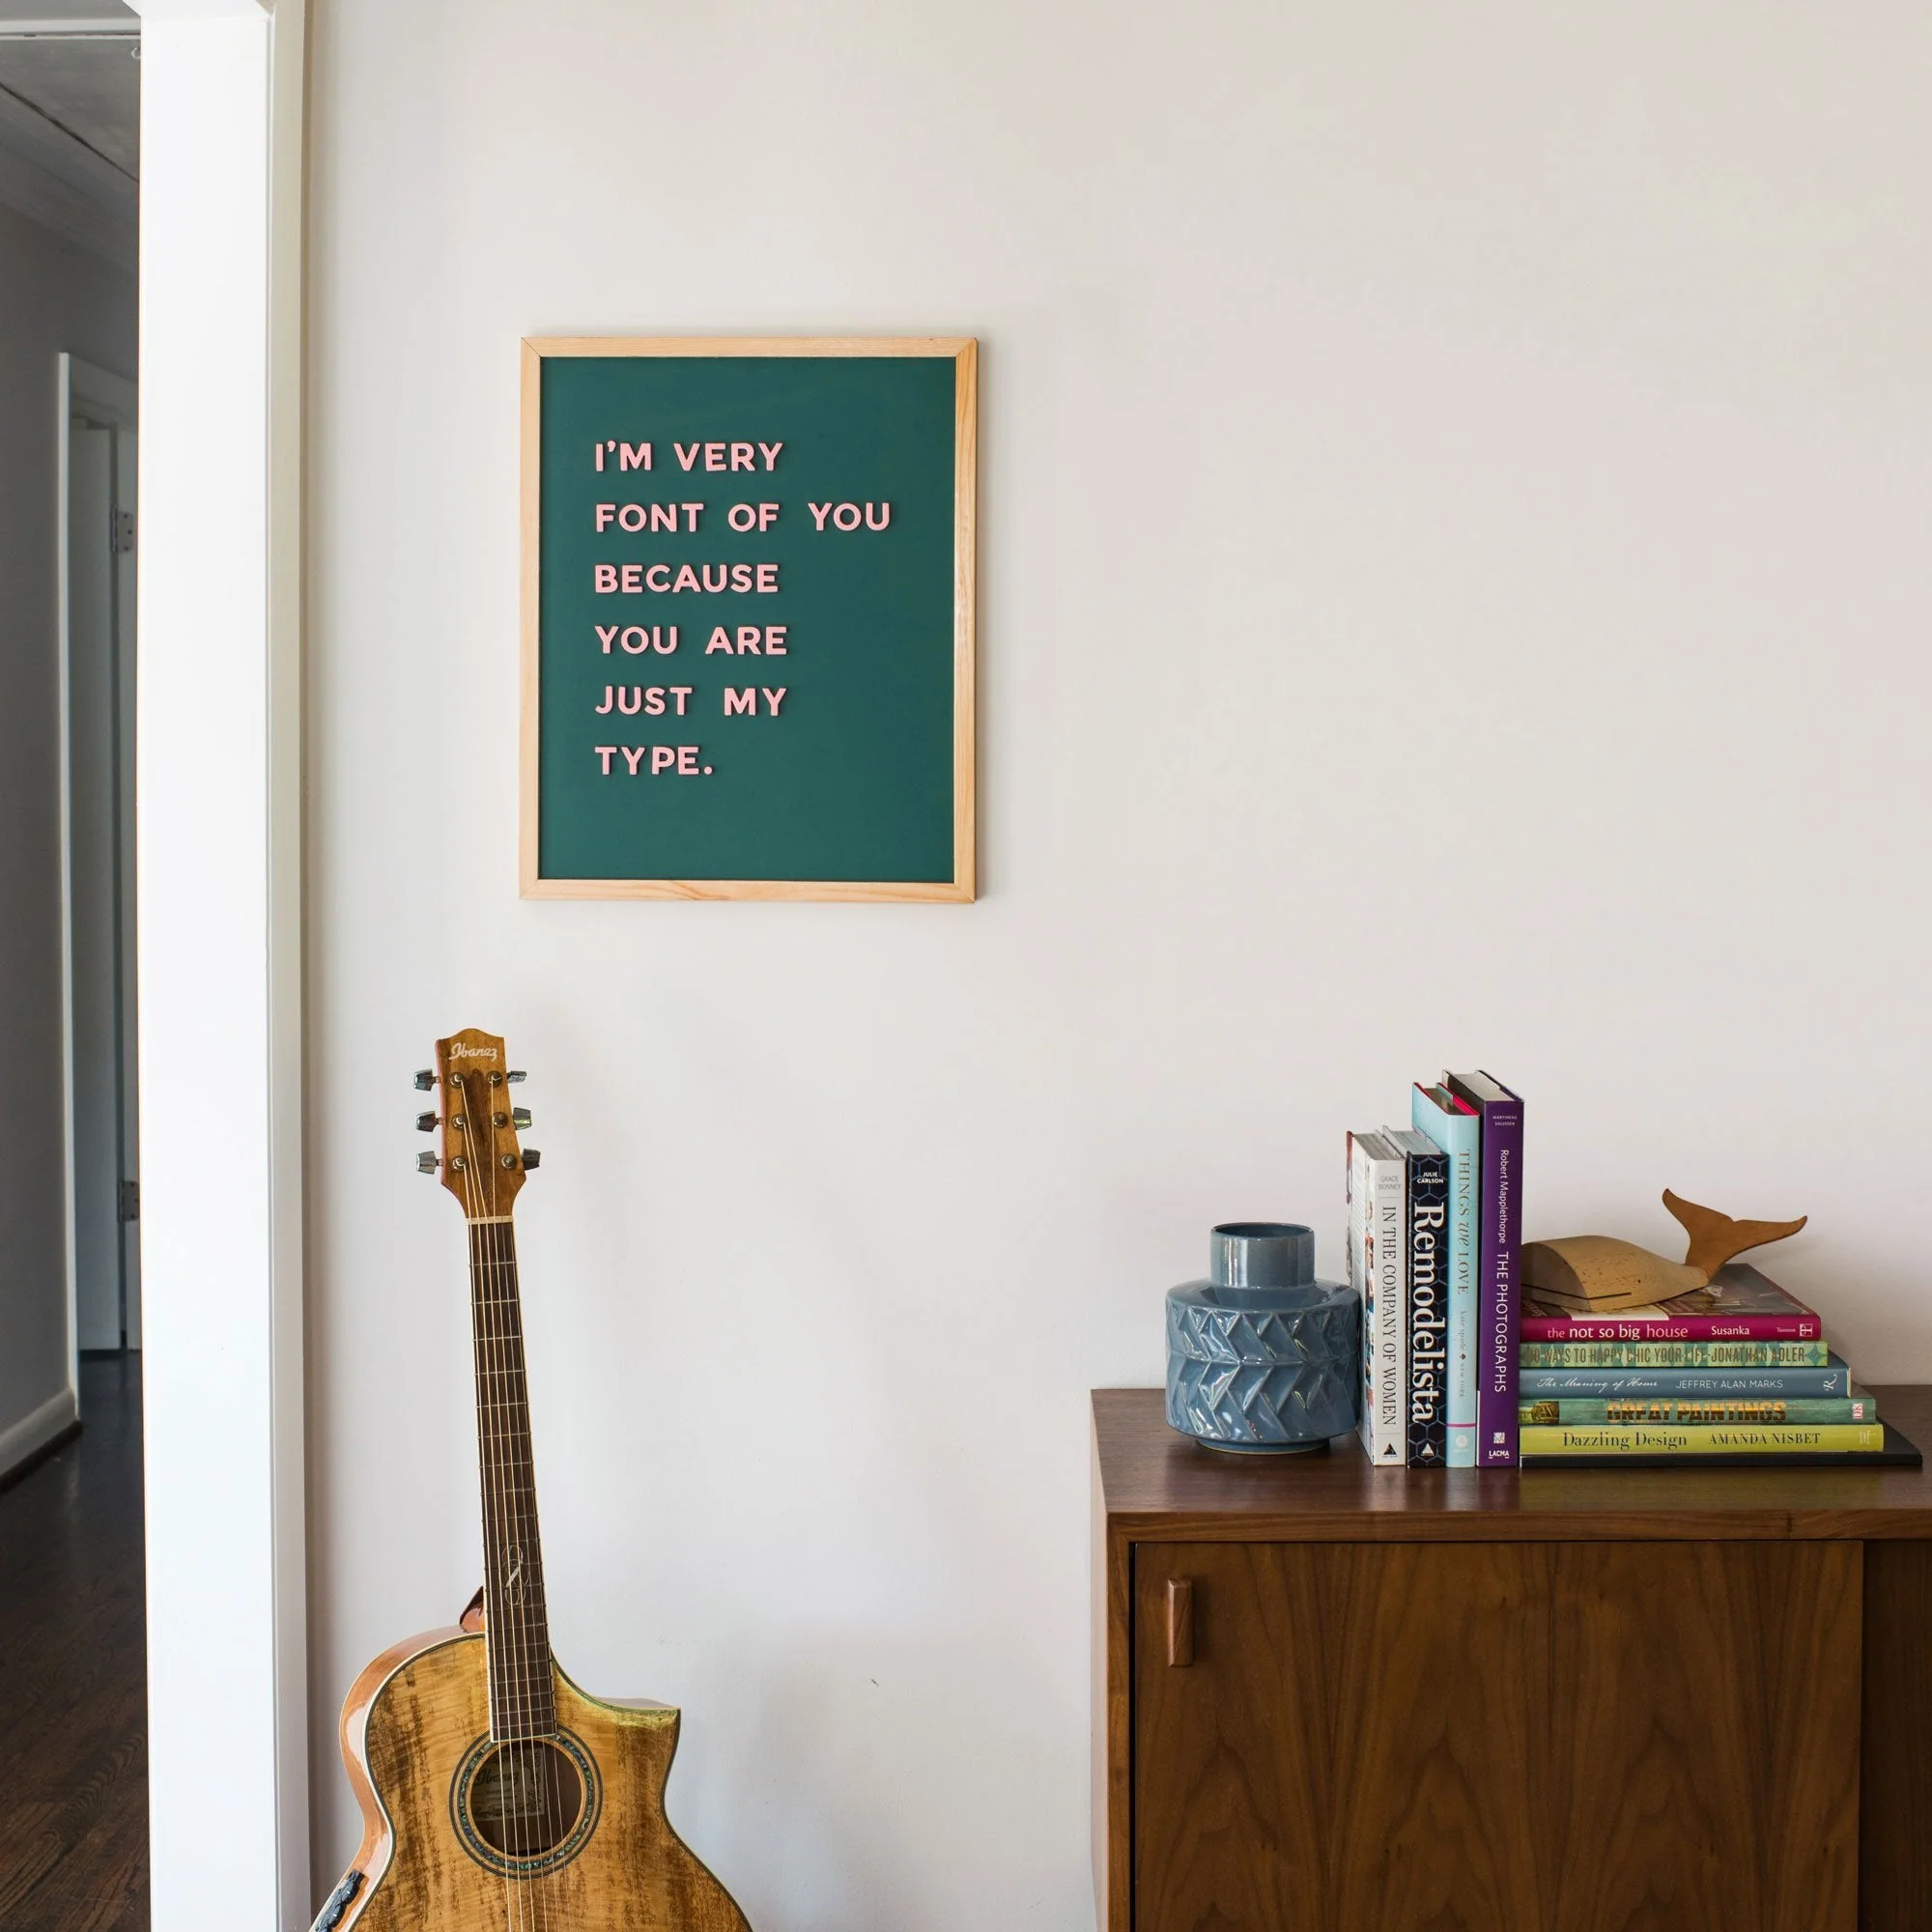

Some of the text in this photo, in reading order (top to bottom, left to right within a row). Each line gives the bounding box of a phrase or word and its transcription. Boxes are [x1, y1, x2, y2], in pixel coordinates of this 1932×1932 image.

[595, 440, 783, 471] I'M VERY
[594, 501, 891, 533] FONT OF YOU
[594, 564, 779, 593] BECAUSE
[594, 625, 788, 656] YOU ARE
[594, 685, 788, 717] JUST MY
[594, 745, 714, 776] TYPE.
[448, 1042, 497, 1062] Ibanez
[1498, 1150, 1510, 1244] Robert Mapplethorpe
[1457, 1149, 1470, 1295] THINGS we LOVE
[1382, 1206, 1397, 1426] IN THE COMPANY OF WOMEN
[1412, 1202, 1445, 1423] Remodelista
[1494, 1251, 1509, 1392] THE PHOTOGRAPHS
[1458, 1329, 1467, 1351] spade
[1548, 1323, 1689, 1341] the not so big house
[1711, 1325, 1750, 1336] Susanka
[1546, 1348, 1571, 1363] WAYS
[1574, 1348, 1586, 1363] TO
[1589, 1348, 1624, 1363] HAPPY
[1626, 1348, 1651, 1363] CHIC
[1655, 1347, 1682, 1363] YOUR
[1685, 1347, 1704, 1362] LIFE
[1711, 1347, 1768, 1362] JONATHAN
[1772, 1347, 1804, 1362] ADLER
[1537, 1377, 1659, 1393] The Meaning of Home
[1675, 1379, 1783, 1389] JEFFREY ALAN MARKS
[1607, 1401, 1786, 1423] GREAT PAINTINGS
[1854, 1405, 1861, 1419] DK
[1563, 1432, 1688, 1451] Dazzling Design
[1708, 1433, 1821, 1445] AMANDA NISBET
